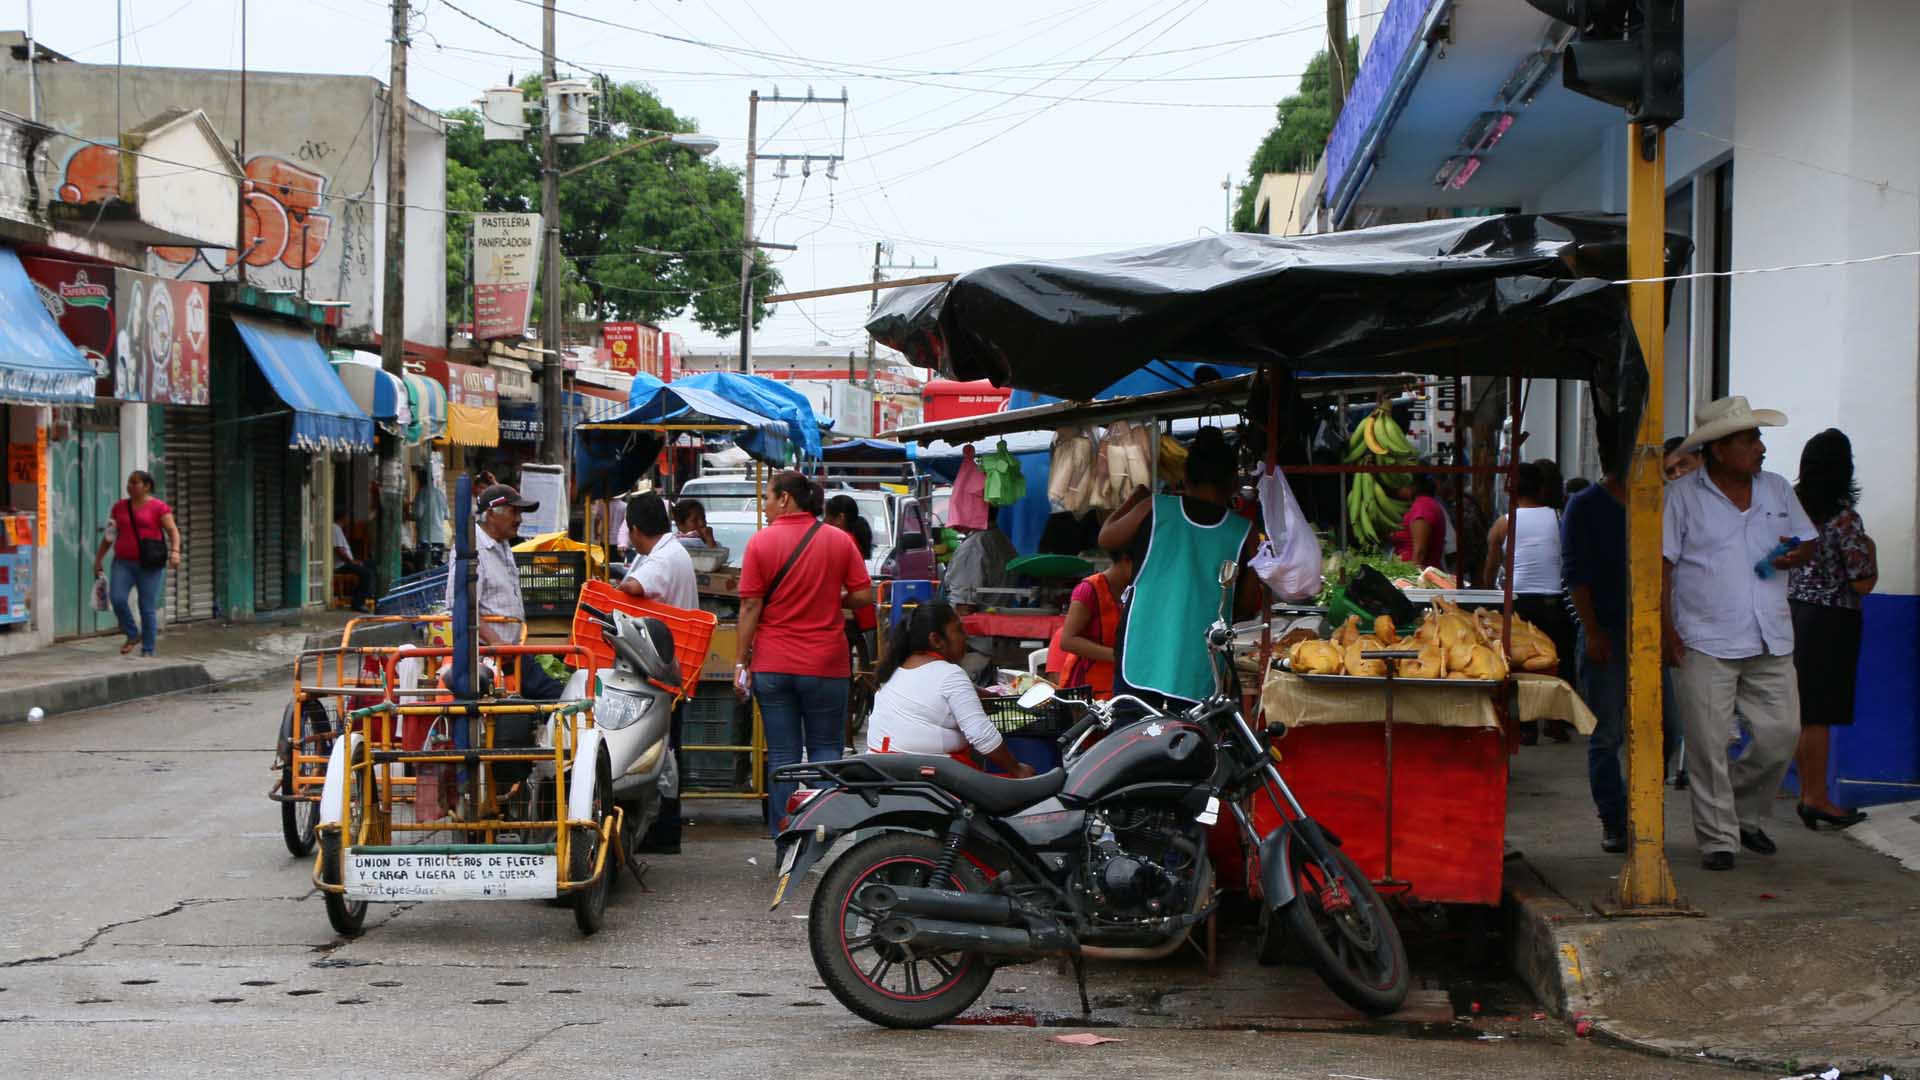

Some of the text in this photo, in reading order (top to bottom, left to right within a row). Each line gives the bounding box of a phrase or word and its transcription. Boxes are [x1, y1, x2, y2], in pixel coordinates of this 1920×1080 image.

[481, 217, 531, 228] PASTELERIA
[478, 237, 532, 248] PANIFICADORA
[355, 858, 391, 868] UNION
[397, 857, 412, 867] DE
[488, 857, 502, 867] DE
[506, 856, 545, 867] FLETES
[359, 871, 365, 880] Y
[372, 871, 409, 880] CARGA
[415, 870, 457, 880] LIGERA
[463, 870, 477, 880] DE
[499, 869, 537, 880] CUENCA
